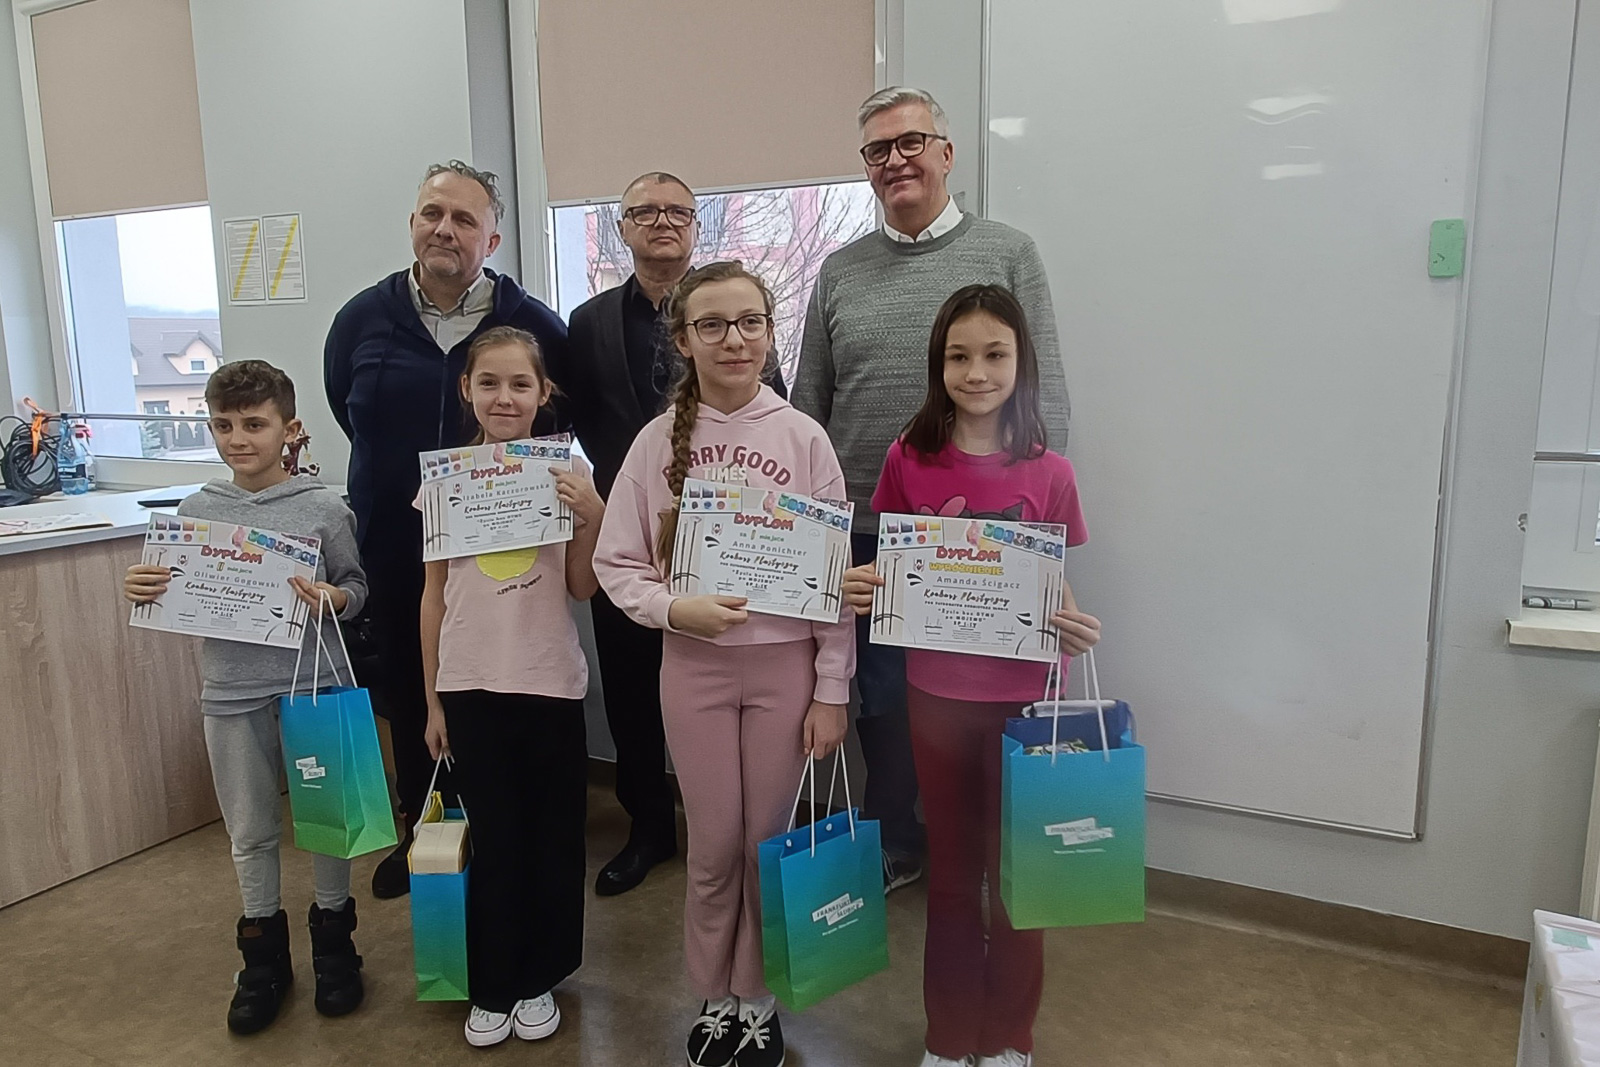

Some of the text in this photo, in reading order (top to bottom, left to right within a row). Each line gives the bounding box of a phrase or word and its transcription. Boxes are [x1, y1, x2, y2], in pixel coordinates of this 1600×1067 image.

[471, 463, 523, 480] DYPLOM
[661, 444, 792, 486] RRY GOOD
[702, 467, 747, 481] TIMES
[463, 483, 550, 501] Izabela Kaczorowska
[734, 512, 794, 531] DYPLOM
[200, 545, 262, 565] DYPLOM
[732, 541, 807, 556] Anna Ponichter
[936, 546, 1002, 563] DYPLOM
[194, 570, 279, 588] Oliwier Gogowski
[936, 576, 1020, 589] Amanda Ścigacz
